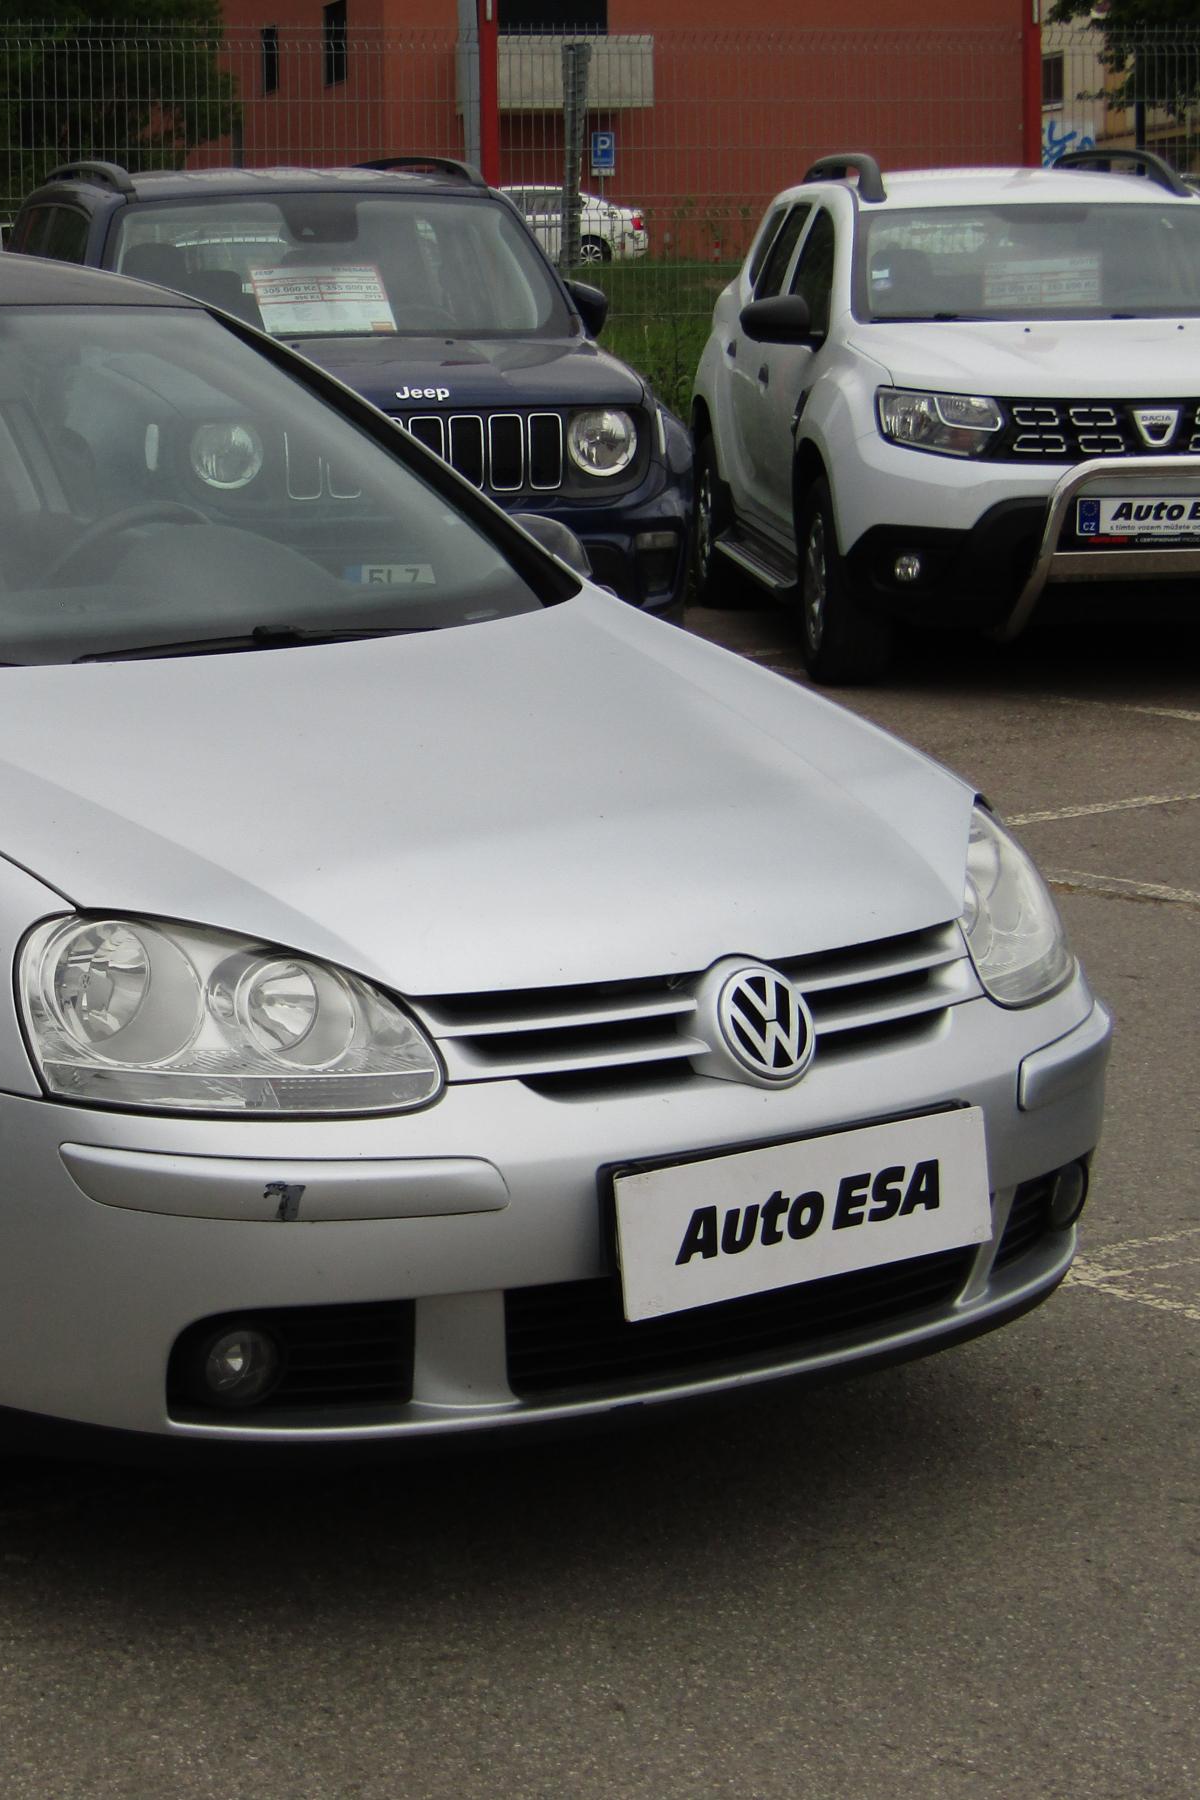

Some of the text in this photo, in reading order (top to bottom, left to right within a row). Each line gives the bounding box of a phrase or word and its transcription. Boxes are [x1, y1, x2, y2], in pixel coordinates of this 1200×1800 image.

[598, 136, 611, 157] P
[396, 386, 450, 401] Jeep
[1111, 502, 1185, 521] Auto
[1083, 522, 1096, 531] CZ
[675, 1158, 940, 1266] Auto ESA
